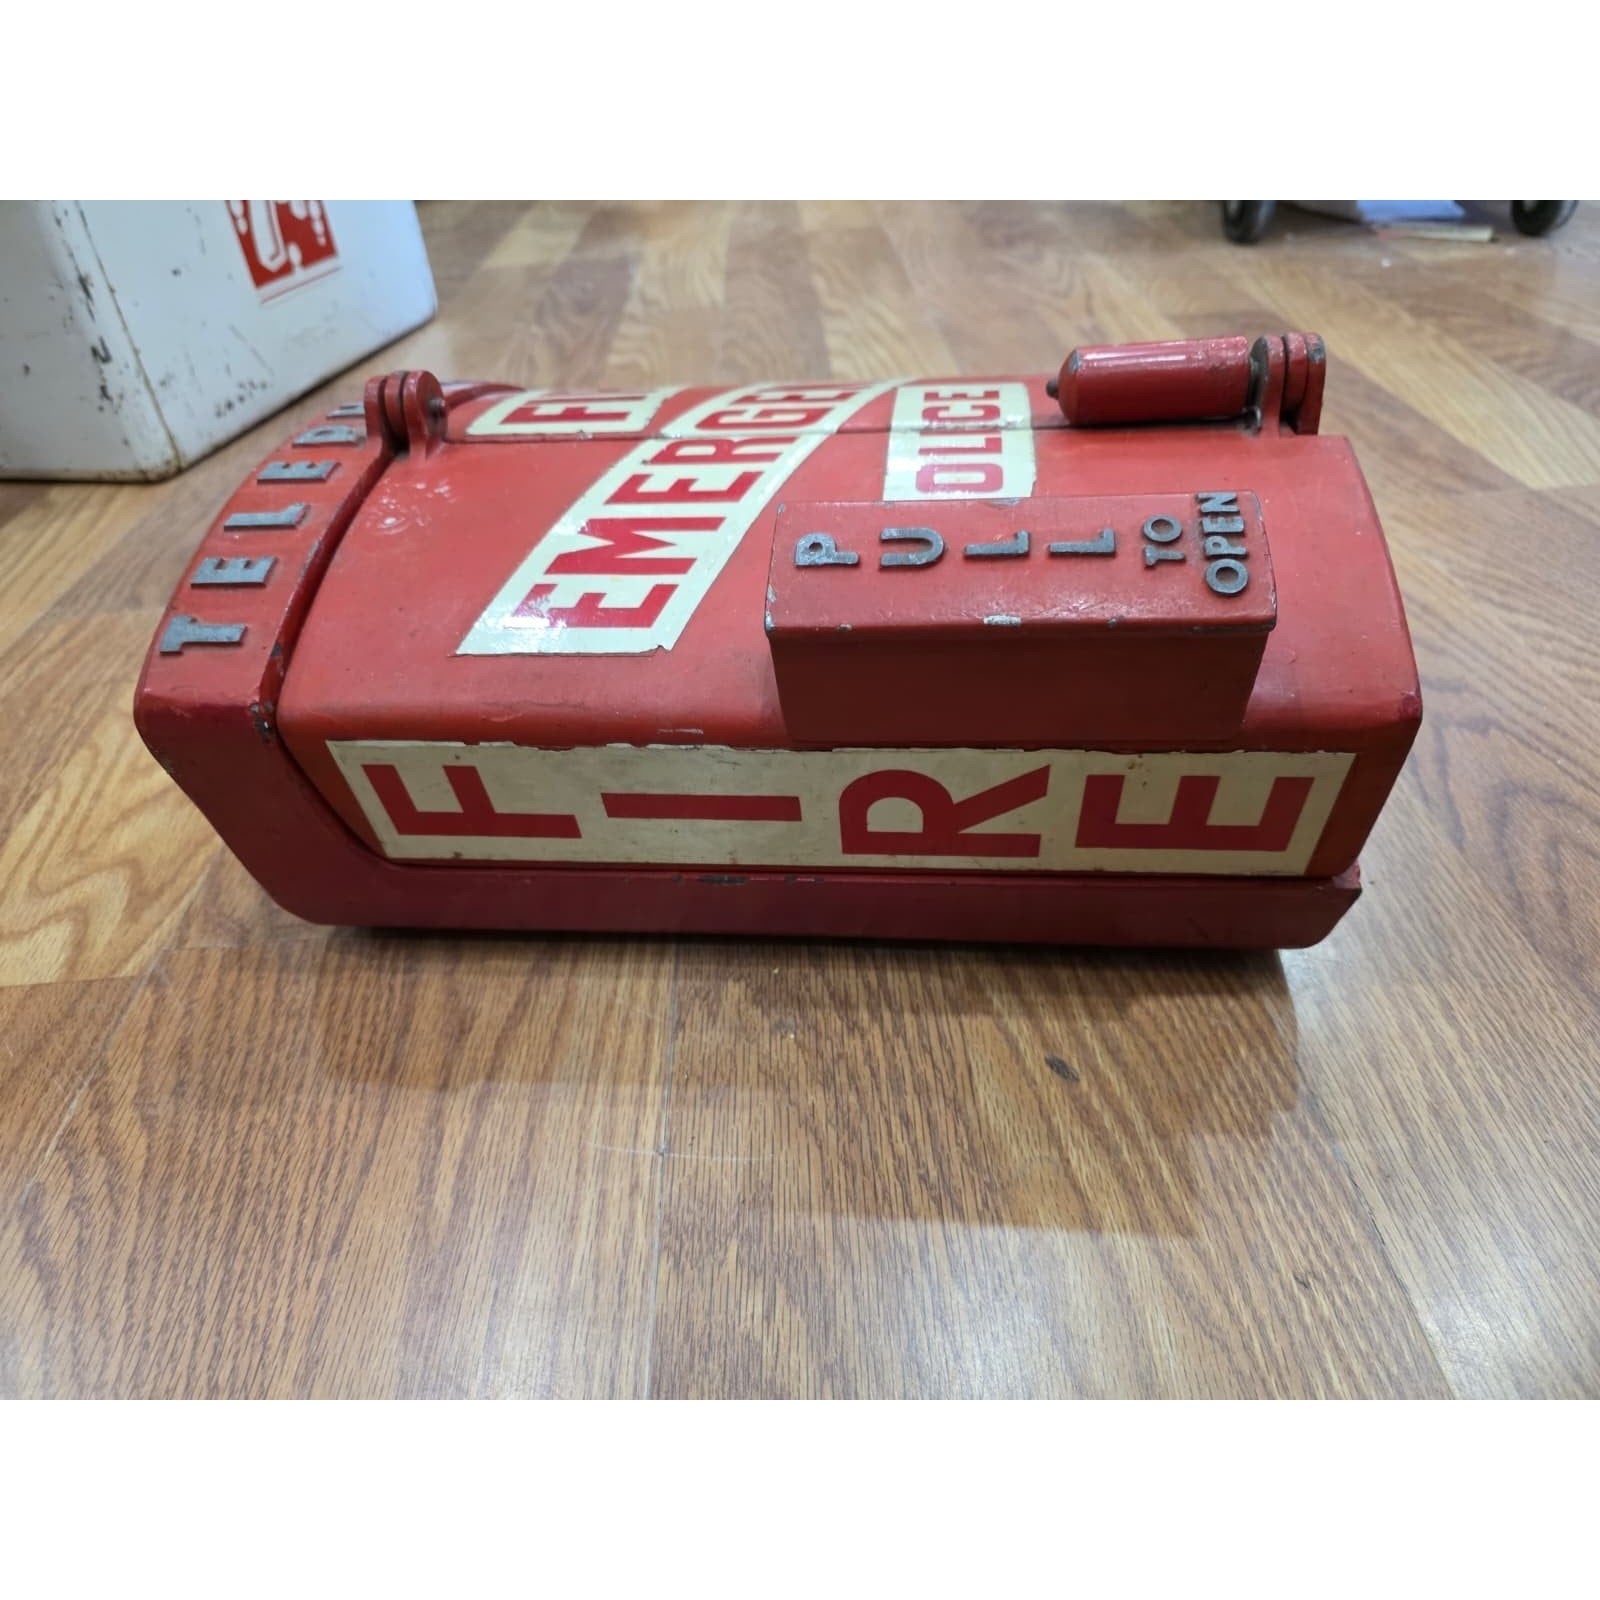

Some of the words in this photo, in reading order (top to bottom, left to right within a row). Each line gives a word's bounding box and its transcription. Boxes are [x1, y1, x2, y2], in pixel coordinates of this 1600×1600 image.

[503, 384, 868, 629] EMERGE
[794, 527, 1117, 569] PULL
[1142, 514, 1187, 568] TO
[1196, 491, 1250, 597] OPEN
[361, 763, 1314, 857] FIRE
